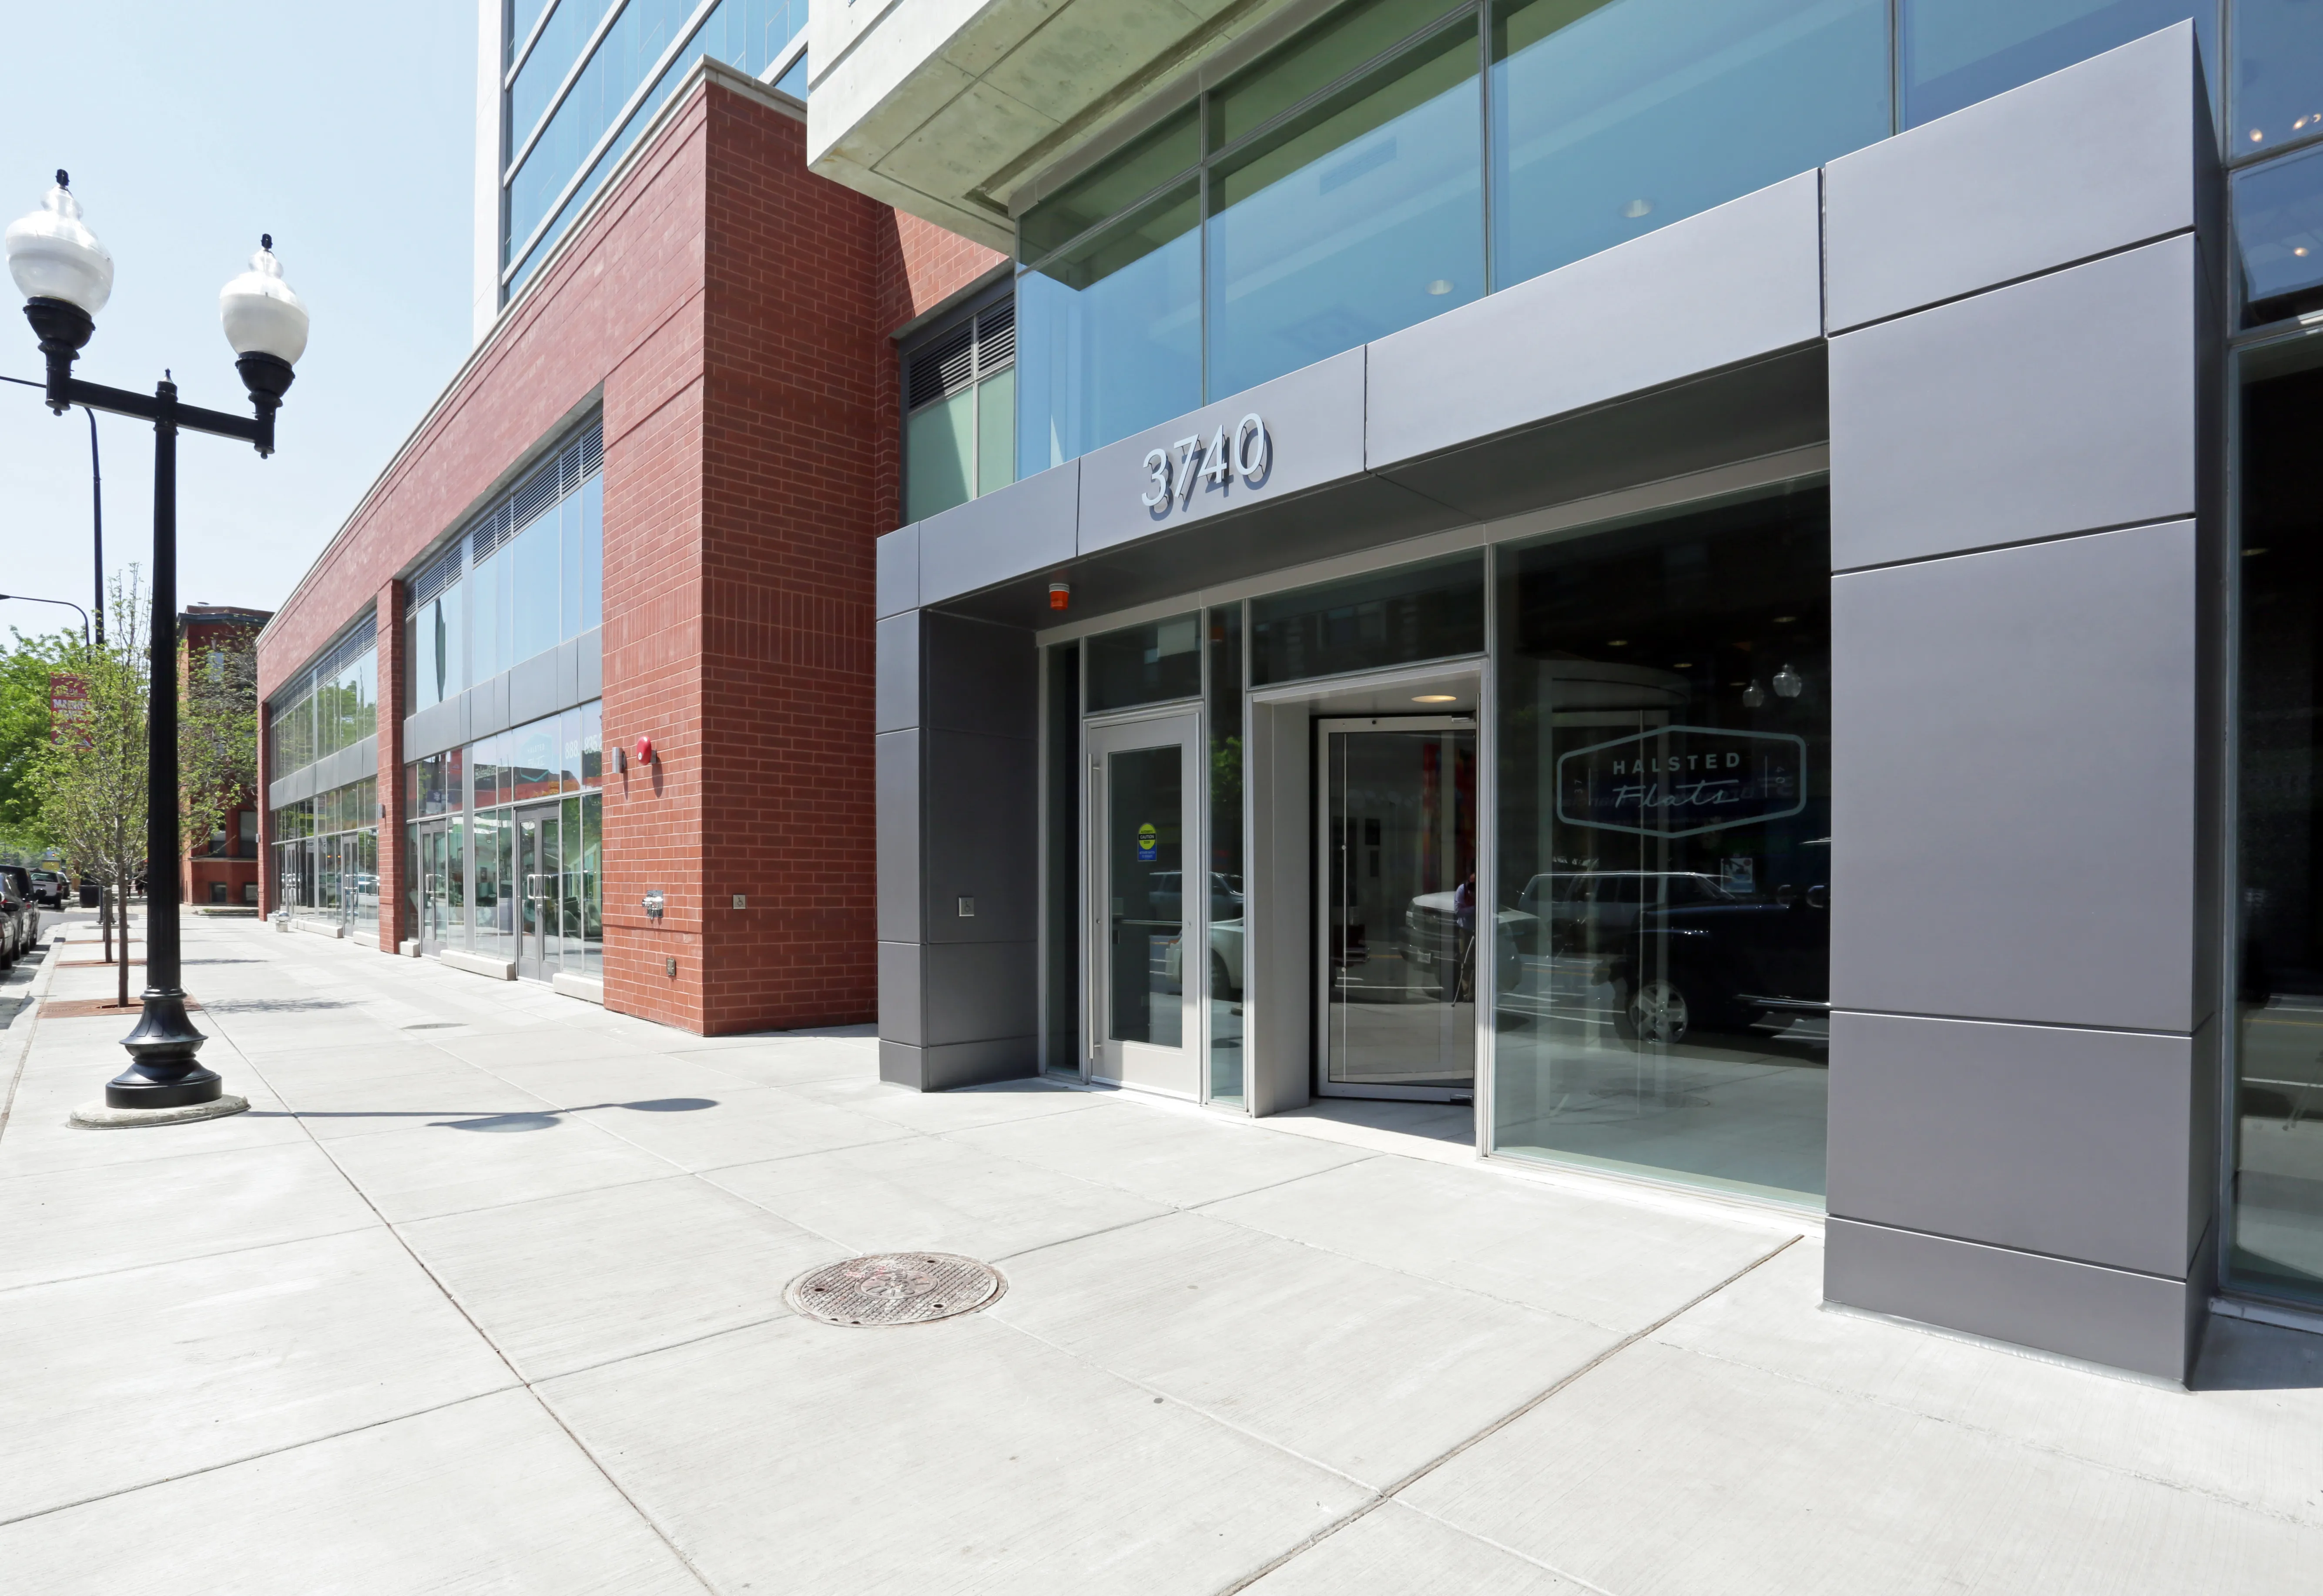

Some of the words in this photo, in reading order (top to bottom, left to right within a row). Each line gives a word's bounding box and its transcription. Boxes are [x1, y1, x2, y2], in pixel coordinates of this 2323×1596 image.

[1142, 412, 1265, 506] 3740
[1613, 752, 1740, 775] HALSTED
[1612, 779, 1740, 809] Flats
